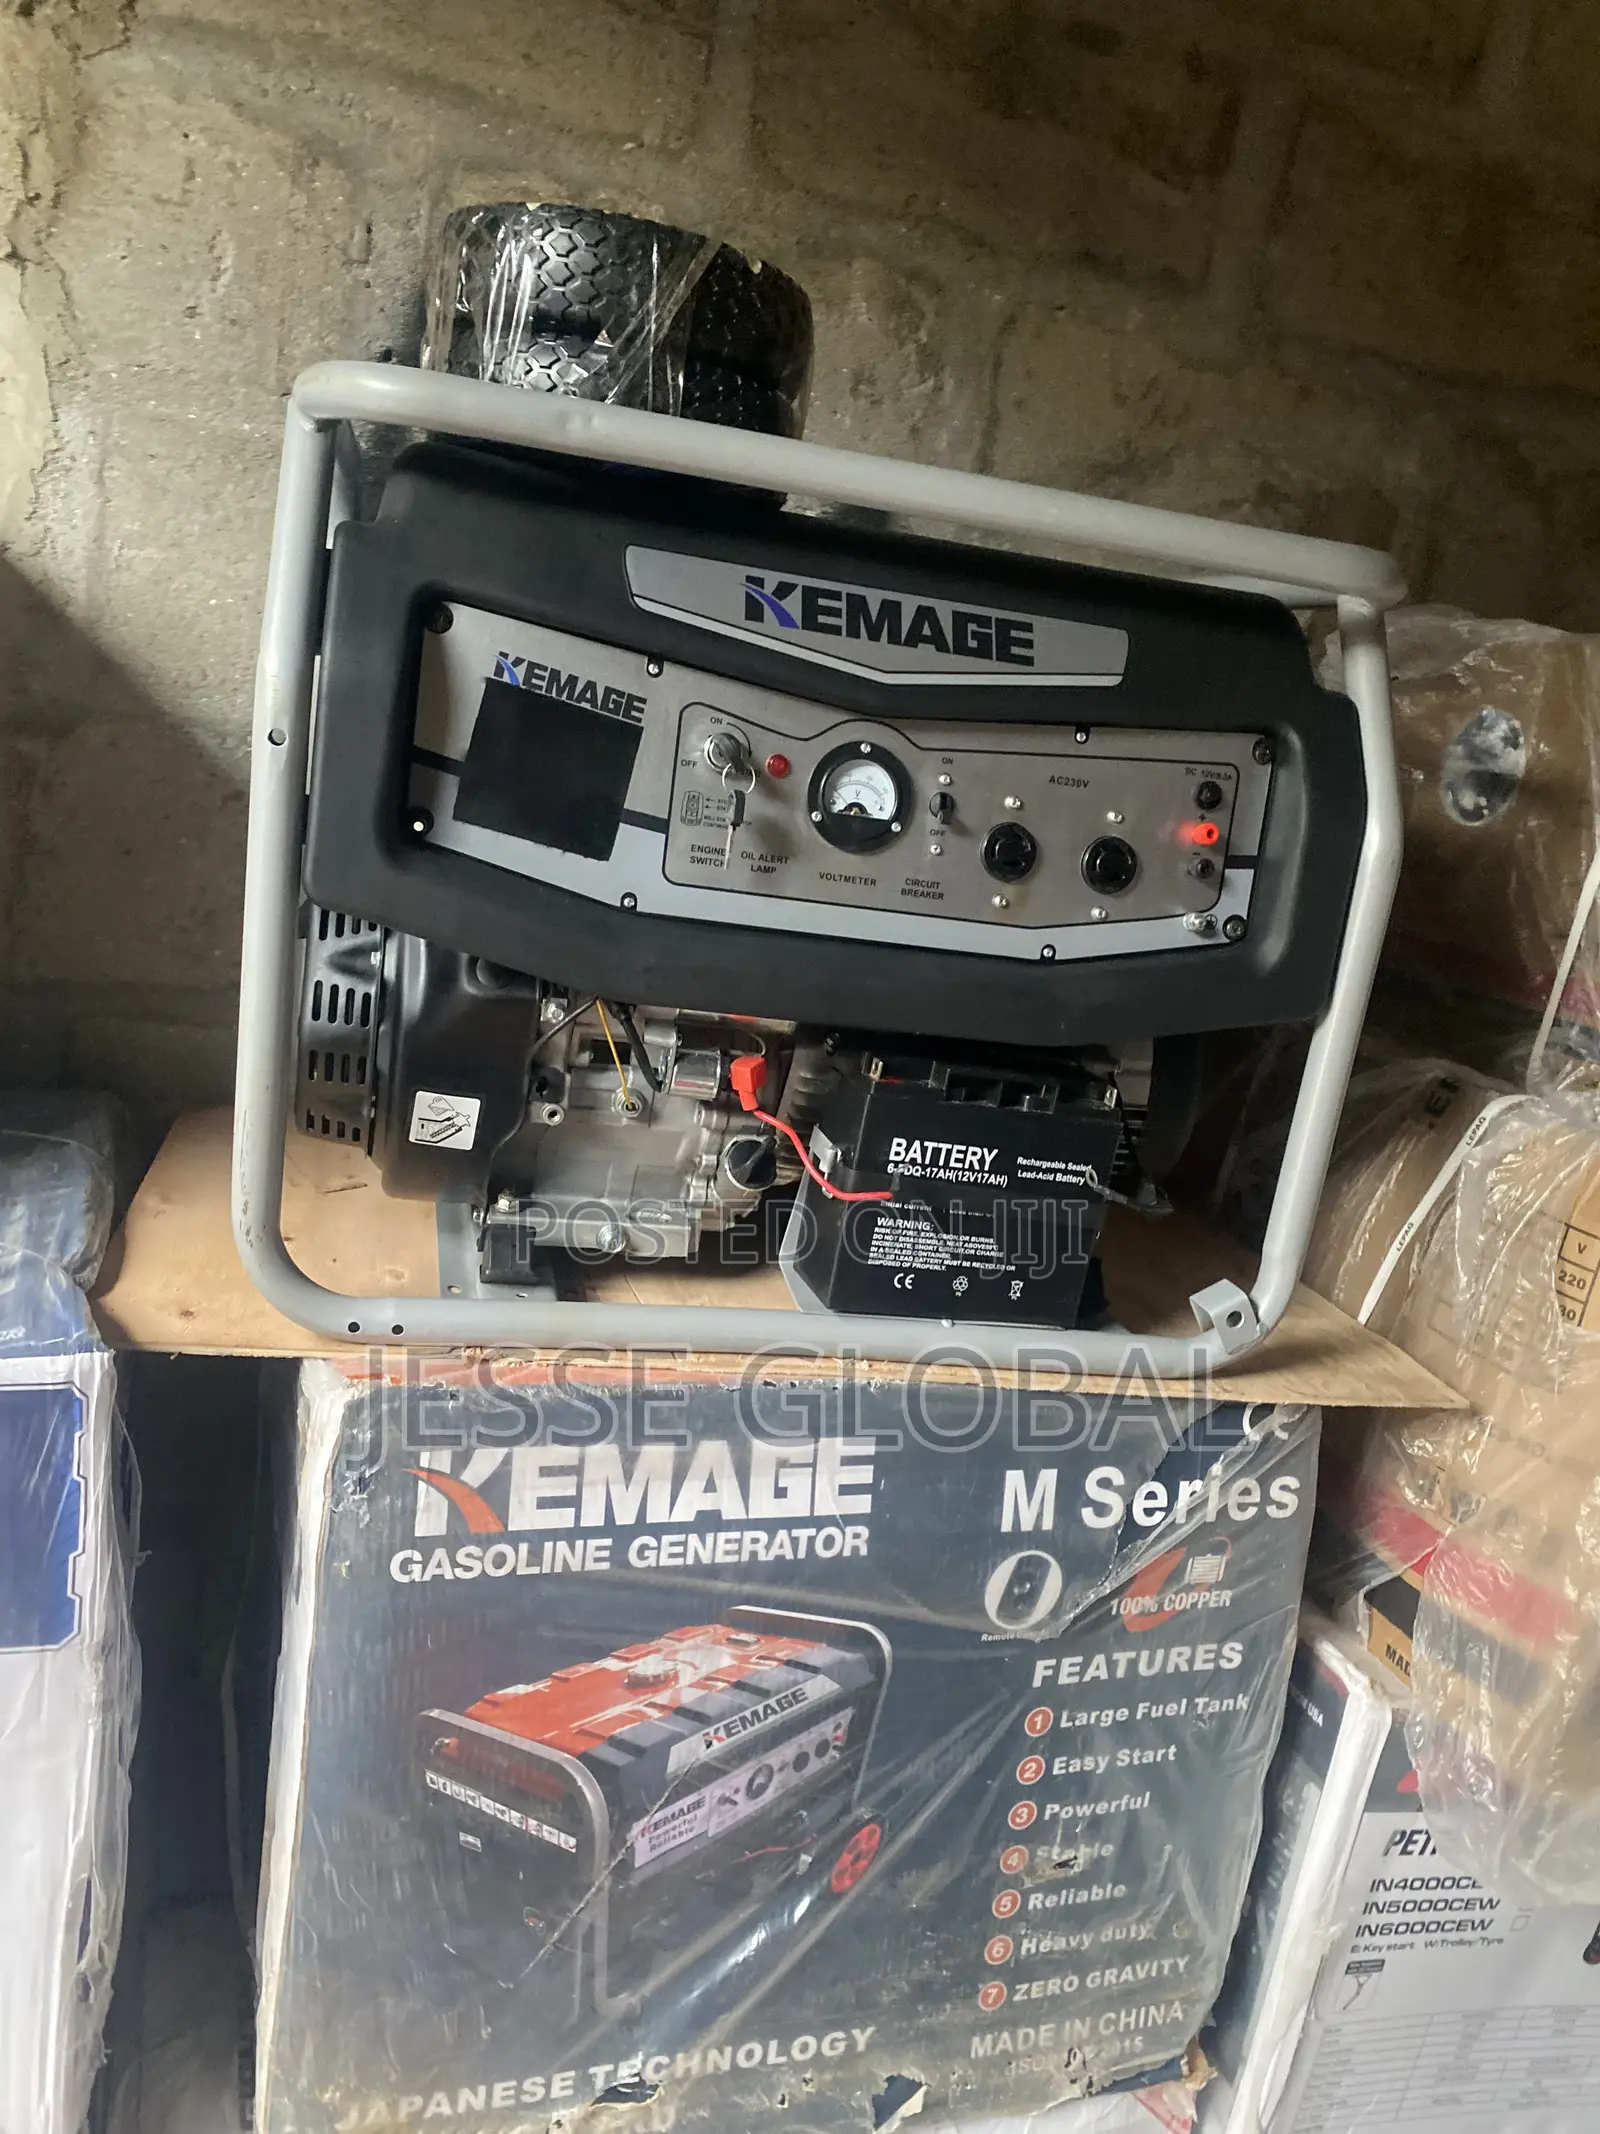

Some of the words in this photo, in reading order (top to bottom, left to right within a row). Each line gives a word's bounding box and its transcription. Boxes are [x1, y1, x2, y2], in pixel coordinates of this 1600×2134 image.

[739, 575, 1035, 667] KEMAGE
[494, 650, 648, 724] KEMAGE
[709, 716, 723, 725] ON
[680, 759, 698, 768] OFF
[941, 757, 954, 765] ON
[1048, 775, 1090, 790] AC230V
[929, 828, 946, 837] OFF
[740, 850, 757, 862] OIL
[758, 852, 790, 865] ALERT
[750, 863, 778, 875] LAMP
[818, 871, 877, 887] VOLTMETER
[905, 877, 942, 890] CIRCUIT
[900, 888, 945, 901] BREAKER
[888, 1137, 999, 1172] BATTERY
[1016, 1156, 1067, 1171] Rechargeable
[1017, 1169, 1055, 1182] Lead-Acid
[1055, 1172, 1086, 1186] Battery
[874, 1227, 891, 1235] RISK
[877, 1216, 934, 1231] WARNING:
[868, 1252, 895, 1261] SEALED
[895, 1254, 913, 1262] LEAD
[914, 1256, 943, 1266] BATTERY
[944, 1259, 961, 1267] MUST
[971, 1261, 1005, 1271] RECYCLED
[885, 1247, 912, 1256] SEALED
[867, 1259, 900, 1268] DISPOSED
[1557, 1268, 1587, 1291] 220
[402, 1436, 877, 1539] KEMAGE
[1000, 1467, 1059, 1534] M
[1080, 1464, 1302, 1530] Series
[389, 1536, 613, 1584] GASOLINE
[627, 1524, 870, 1569] GENERATOR
[1110, 1594, 1159, 1618] 100%
[1163, 1589, 1233, 1612] COPPER
[1032, 1641, 1244, 1688] FEATURES
[702, 1687, 809, 1750] KEMAGE
[1032, 1713, 1045, 1732] 1
[1059, 1705, 1131, 1729] Large
[1136, 1697, 1188, 1721] Fuel
[1194, 1692, 1251, 1716] Tank
[1024, 1761, 1038, 1779] 2
[1052, 1754, 1111, 1777] Easy
[1115, 1743, 1179, 1768] Start
[1015, 1807, 1029, 1825] 3
[1043, 1790, 1152, 1822] Powerful
[1383, 1828, 1437, 1857] PET
[1007, 1851, 1020, 1867] 4
[999, 1895, 1013, 1912] 5
[1028, 1882, 1126, 1911] Reliable
[1362, 1898, 1501, 1915] IN5000CEW
[1355, 1918, 1495, 1938] IN6000CEW
[992, 1941, 1006, 1959] 6
[1020, 1930, 1094, 1956] Heavy
[1100, 1920, 1151, 1943] duty
[987, 1988, 999, 2005] 7
[1012, 1976, 1080, 2003] ZERO
[1085, 1955, 1192, 1989] GRAVITY
[969, 2022, 1057, 2060] MADE
[1062, 2016, 1092, 2042] IN
[1099, 2001, 1184, 2036] CHINA
[334, 2069, 576, 2133] JAPANESE
[588, 2026, 878, 2092] TECHNOLOGY
